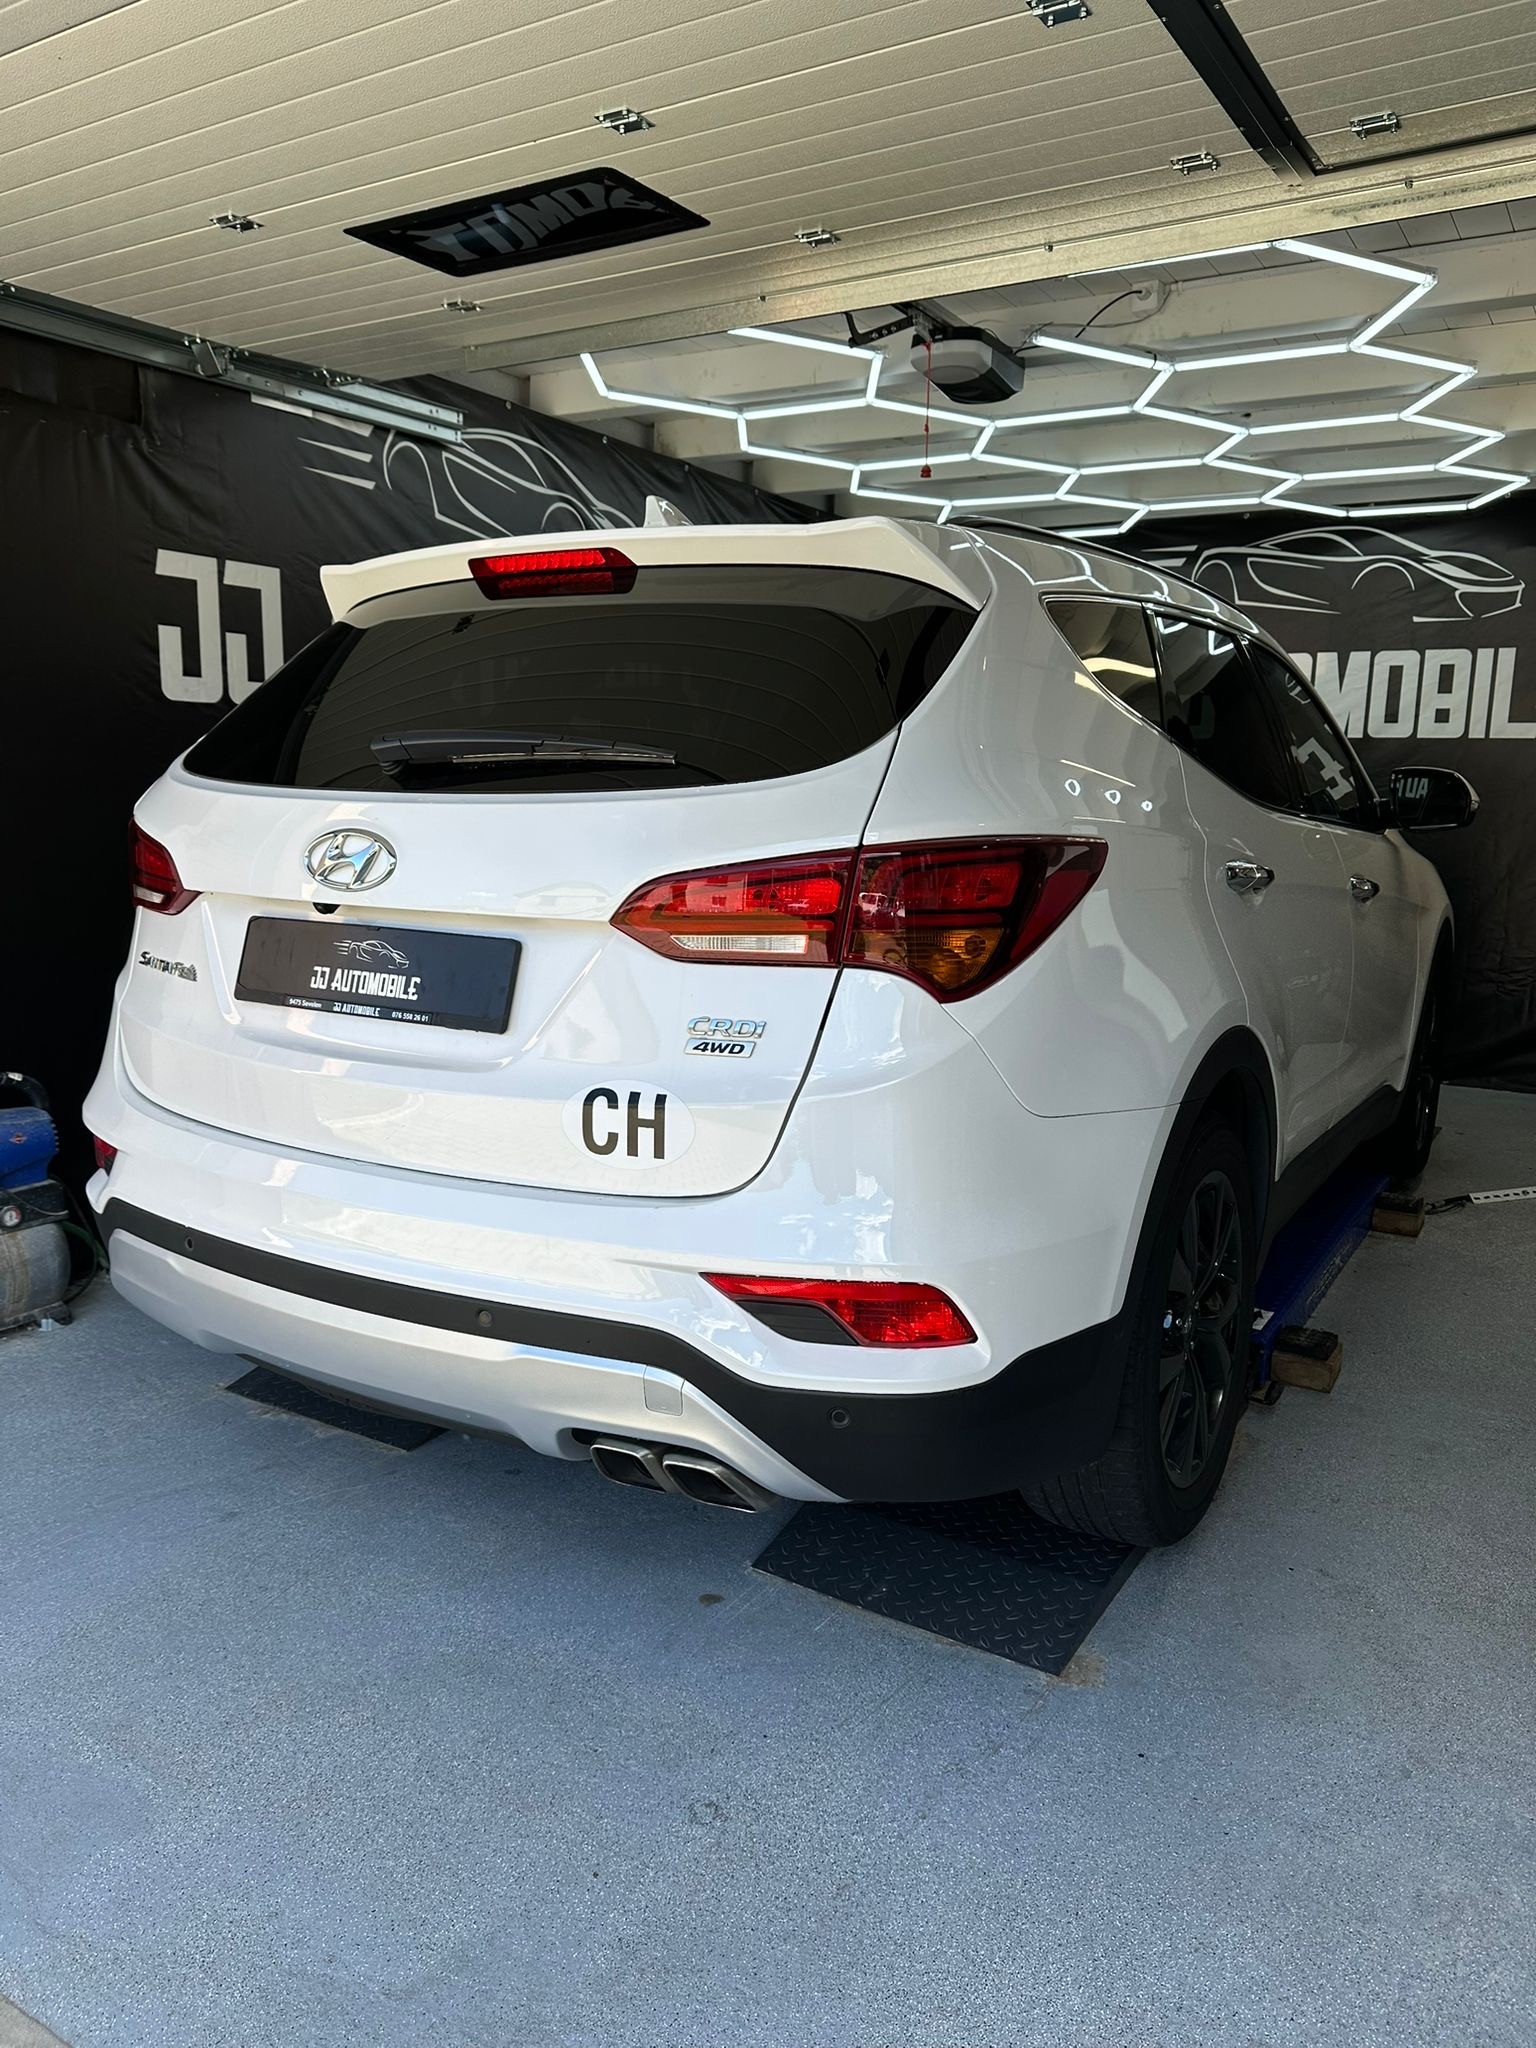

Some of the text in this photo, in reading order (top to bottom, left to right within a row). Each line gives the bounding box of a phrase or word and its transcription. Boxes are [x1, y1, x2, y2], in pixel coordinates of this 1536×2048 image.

[155, 548, 284, 704] JJ
[310, 966, 421, 1000] JJ AUTOMOBILE
[342, 1003, 380, 1017] AUTOMOBILE
[687, 1016, 767, 1039] CRDi
[692, 1041, 746, 1055] 4WD
[582, 1087, 668, 1160] CH
